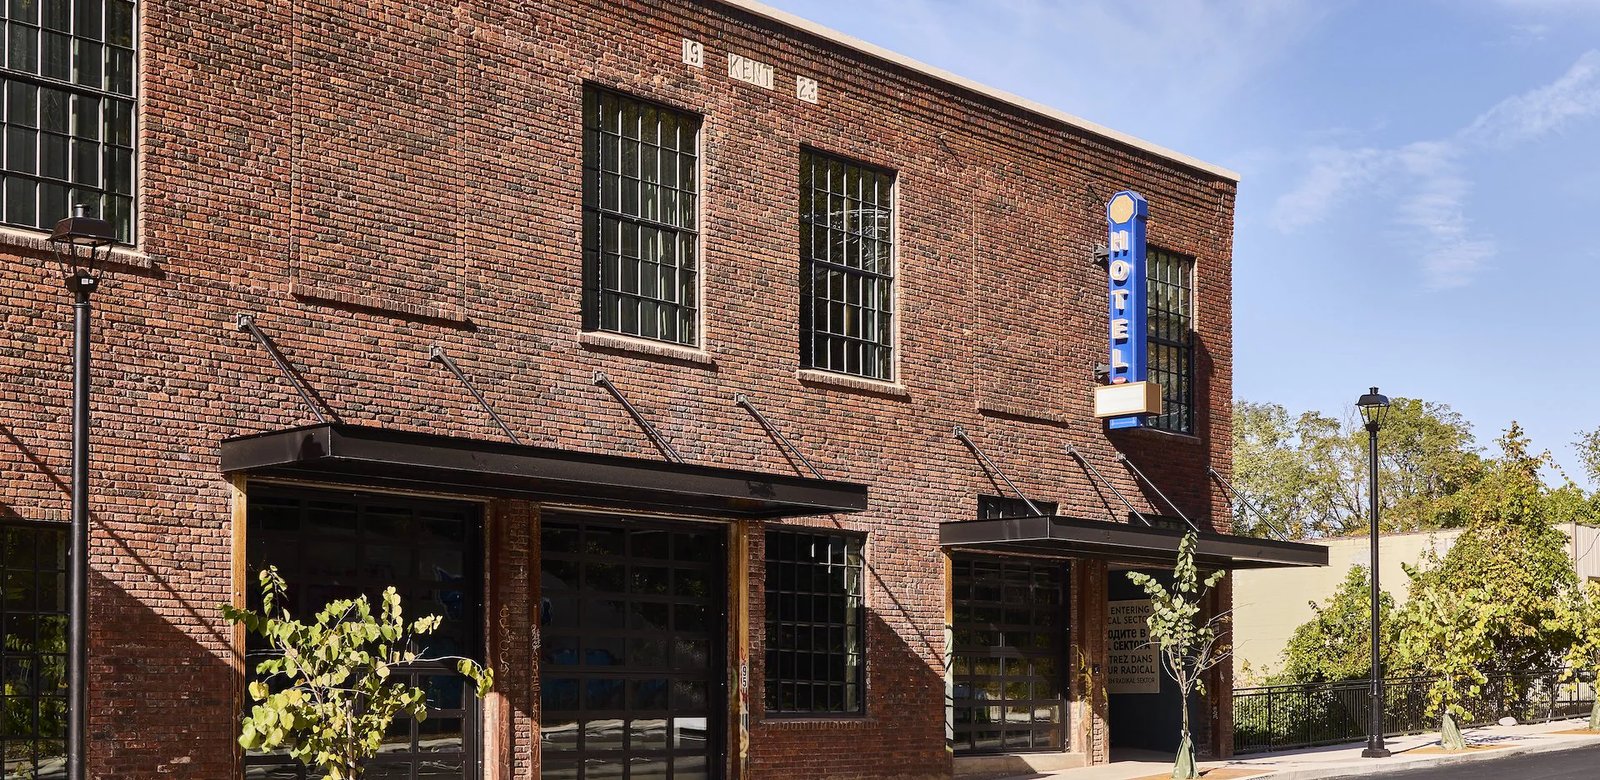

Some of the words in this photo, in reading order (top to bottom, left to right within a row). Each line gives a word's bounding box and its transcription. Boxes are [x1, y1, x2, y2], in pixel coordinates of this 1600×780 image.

[684, 40, 699, 63] 19
[730, 54, 773, 86] KENT
[799, 77, 815, 100] 23
[1110, 230, 1129, 368] HOTEL
[1111, 606, 1149, 615] ENTERING
[1131, 654, 1152, 664] DANS
[1121, 665, 1155, 675] RADICAL
